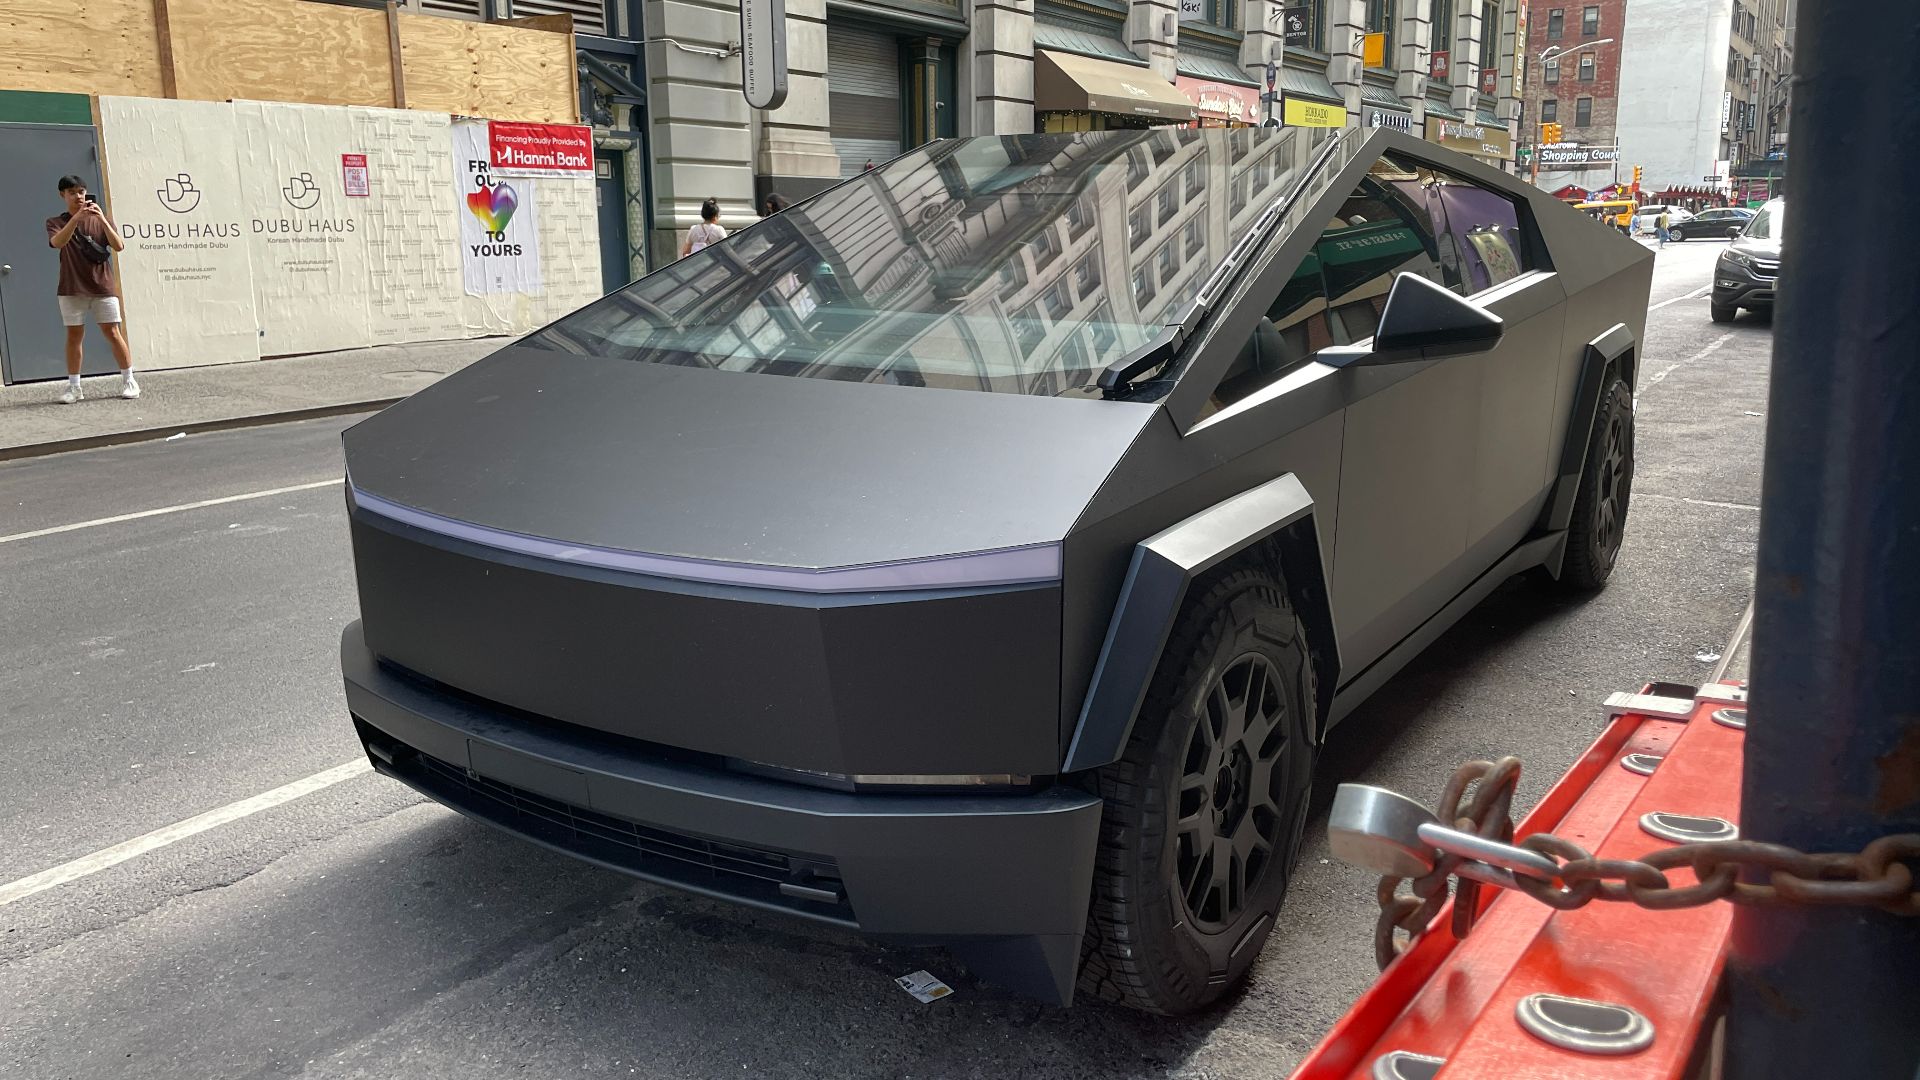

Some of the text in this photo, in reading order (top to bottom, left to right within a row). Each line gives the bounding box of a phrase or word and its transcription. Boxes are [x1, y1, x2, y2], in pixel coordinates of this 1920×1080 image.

[496, 134, 586, 147] Financing Proudly Provided By
[514, 150, 587, 167] Hanmi Bank
[1541, 149, 1620, 163] Shopping Court
[122, 222, 241, 239] DUBU HAUS
[252, 218, 355, 233] DUBU HAUS
[486, 231, 505, 243] TO
[139, 241, 229, 250] Korean Handmade Dubu
[471, 244, 522, 257] YOURS
